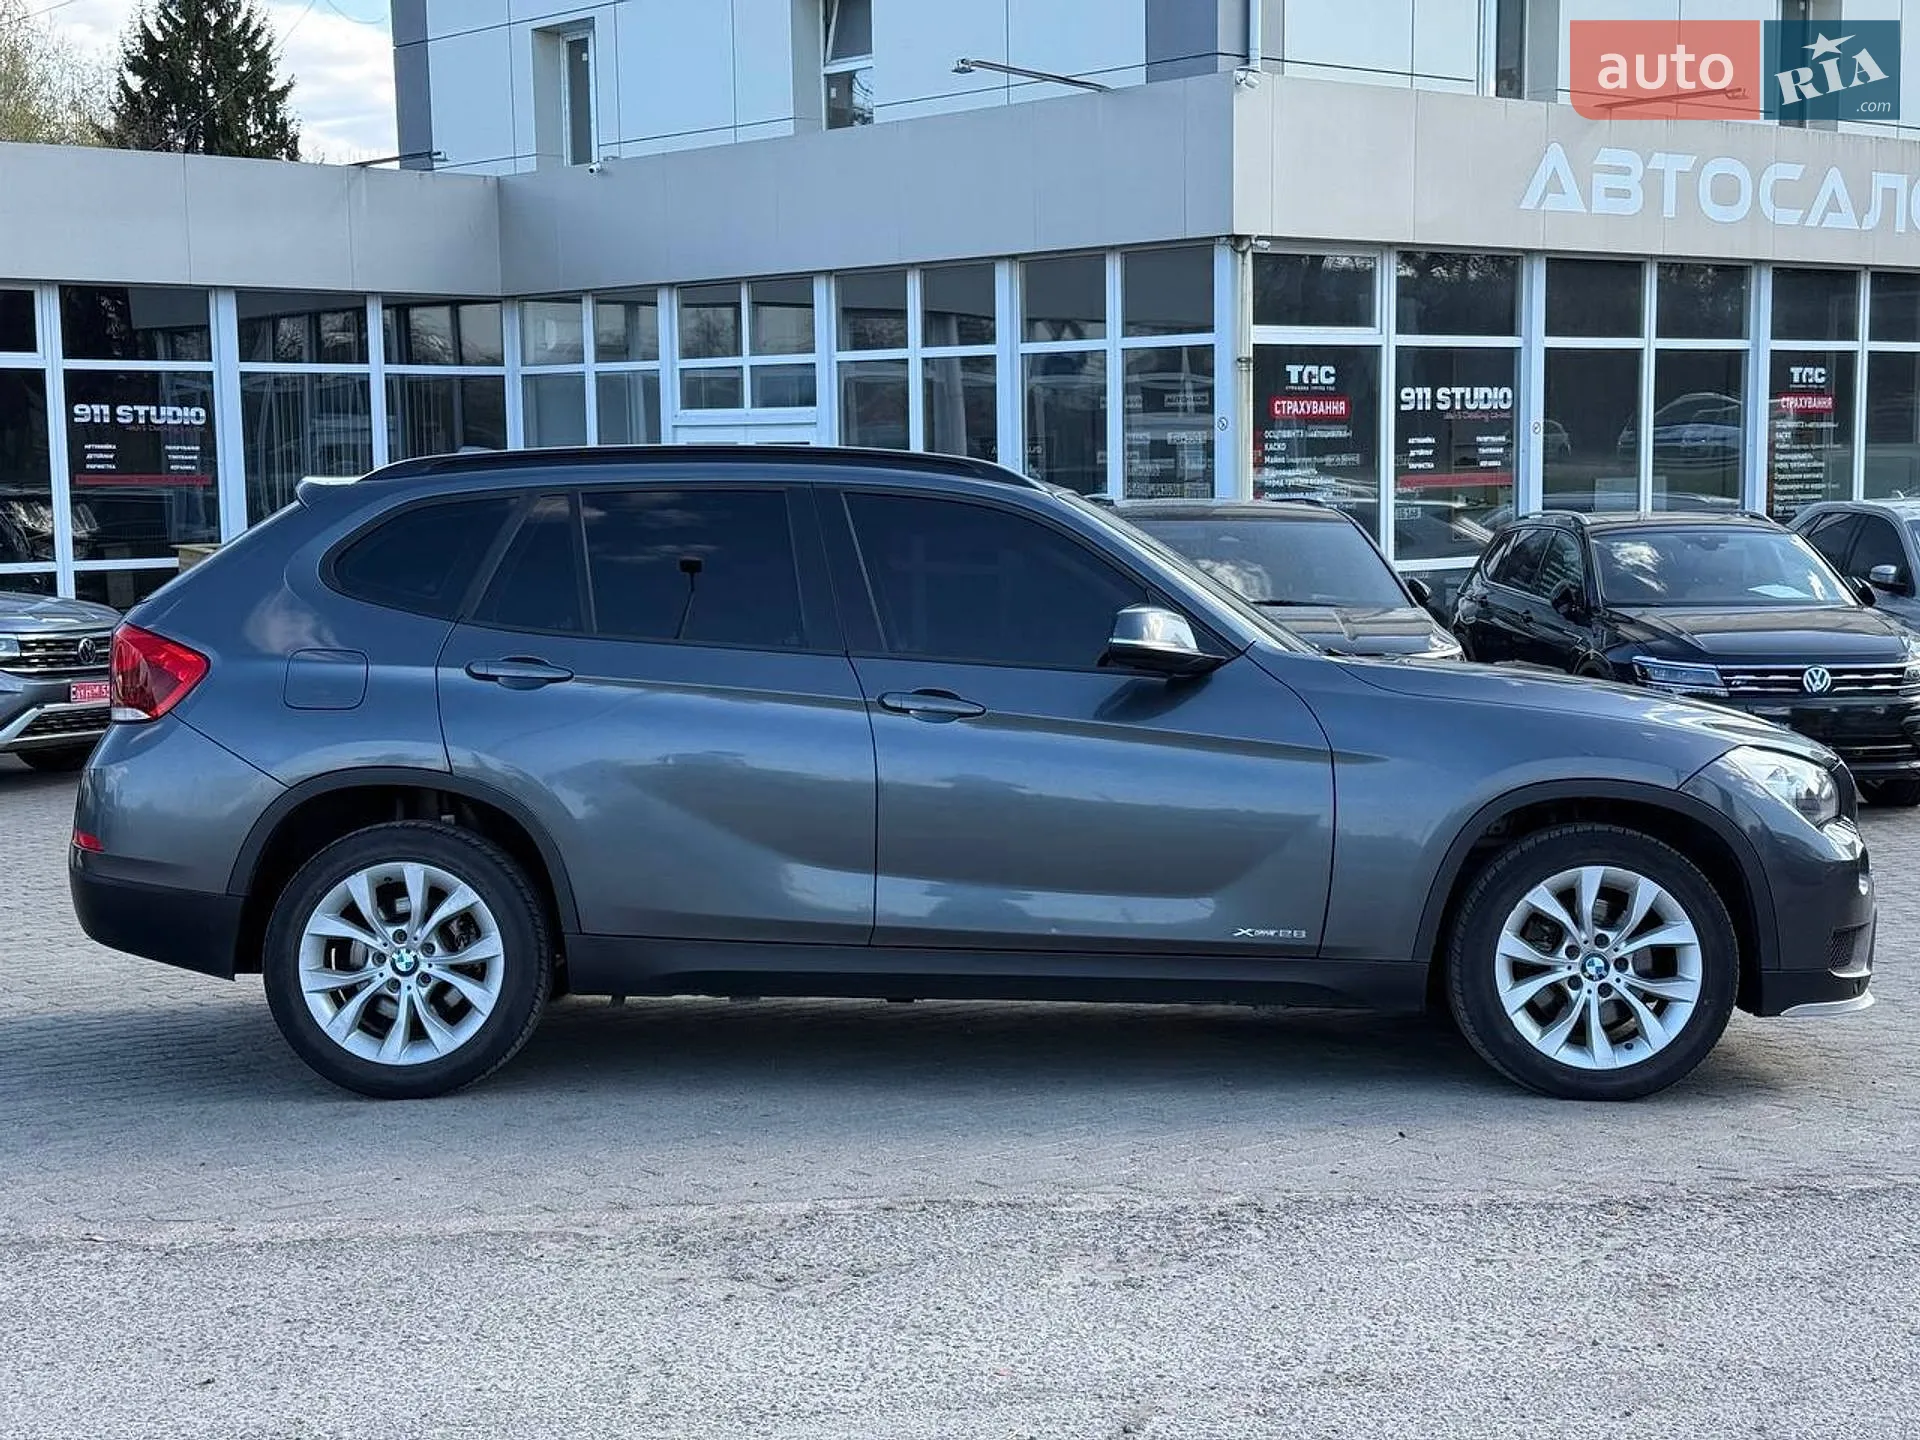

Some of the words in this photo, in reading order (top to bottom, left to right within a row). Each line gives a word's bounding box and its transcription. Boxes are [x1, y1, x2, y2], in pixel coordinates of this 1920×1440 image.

[1519, 141, 1920, 233] АВТОСАЛ
[1274, 400, 1346, 415] СТРАХУВАННЯ
[1400, 387, 1431, 410] 911
[1436, 387, 1513, 410] STUDIO
[73, 403, 110, 423] 911
[116, 405, 206, 425] STUDIO
